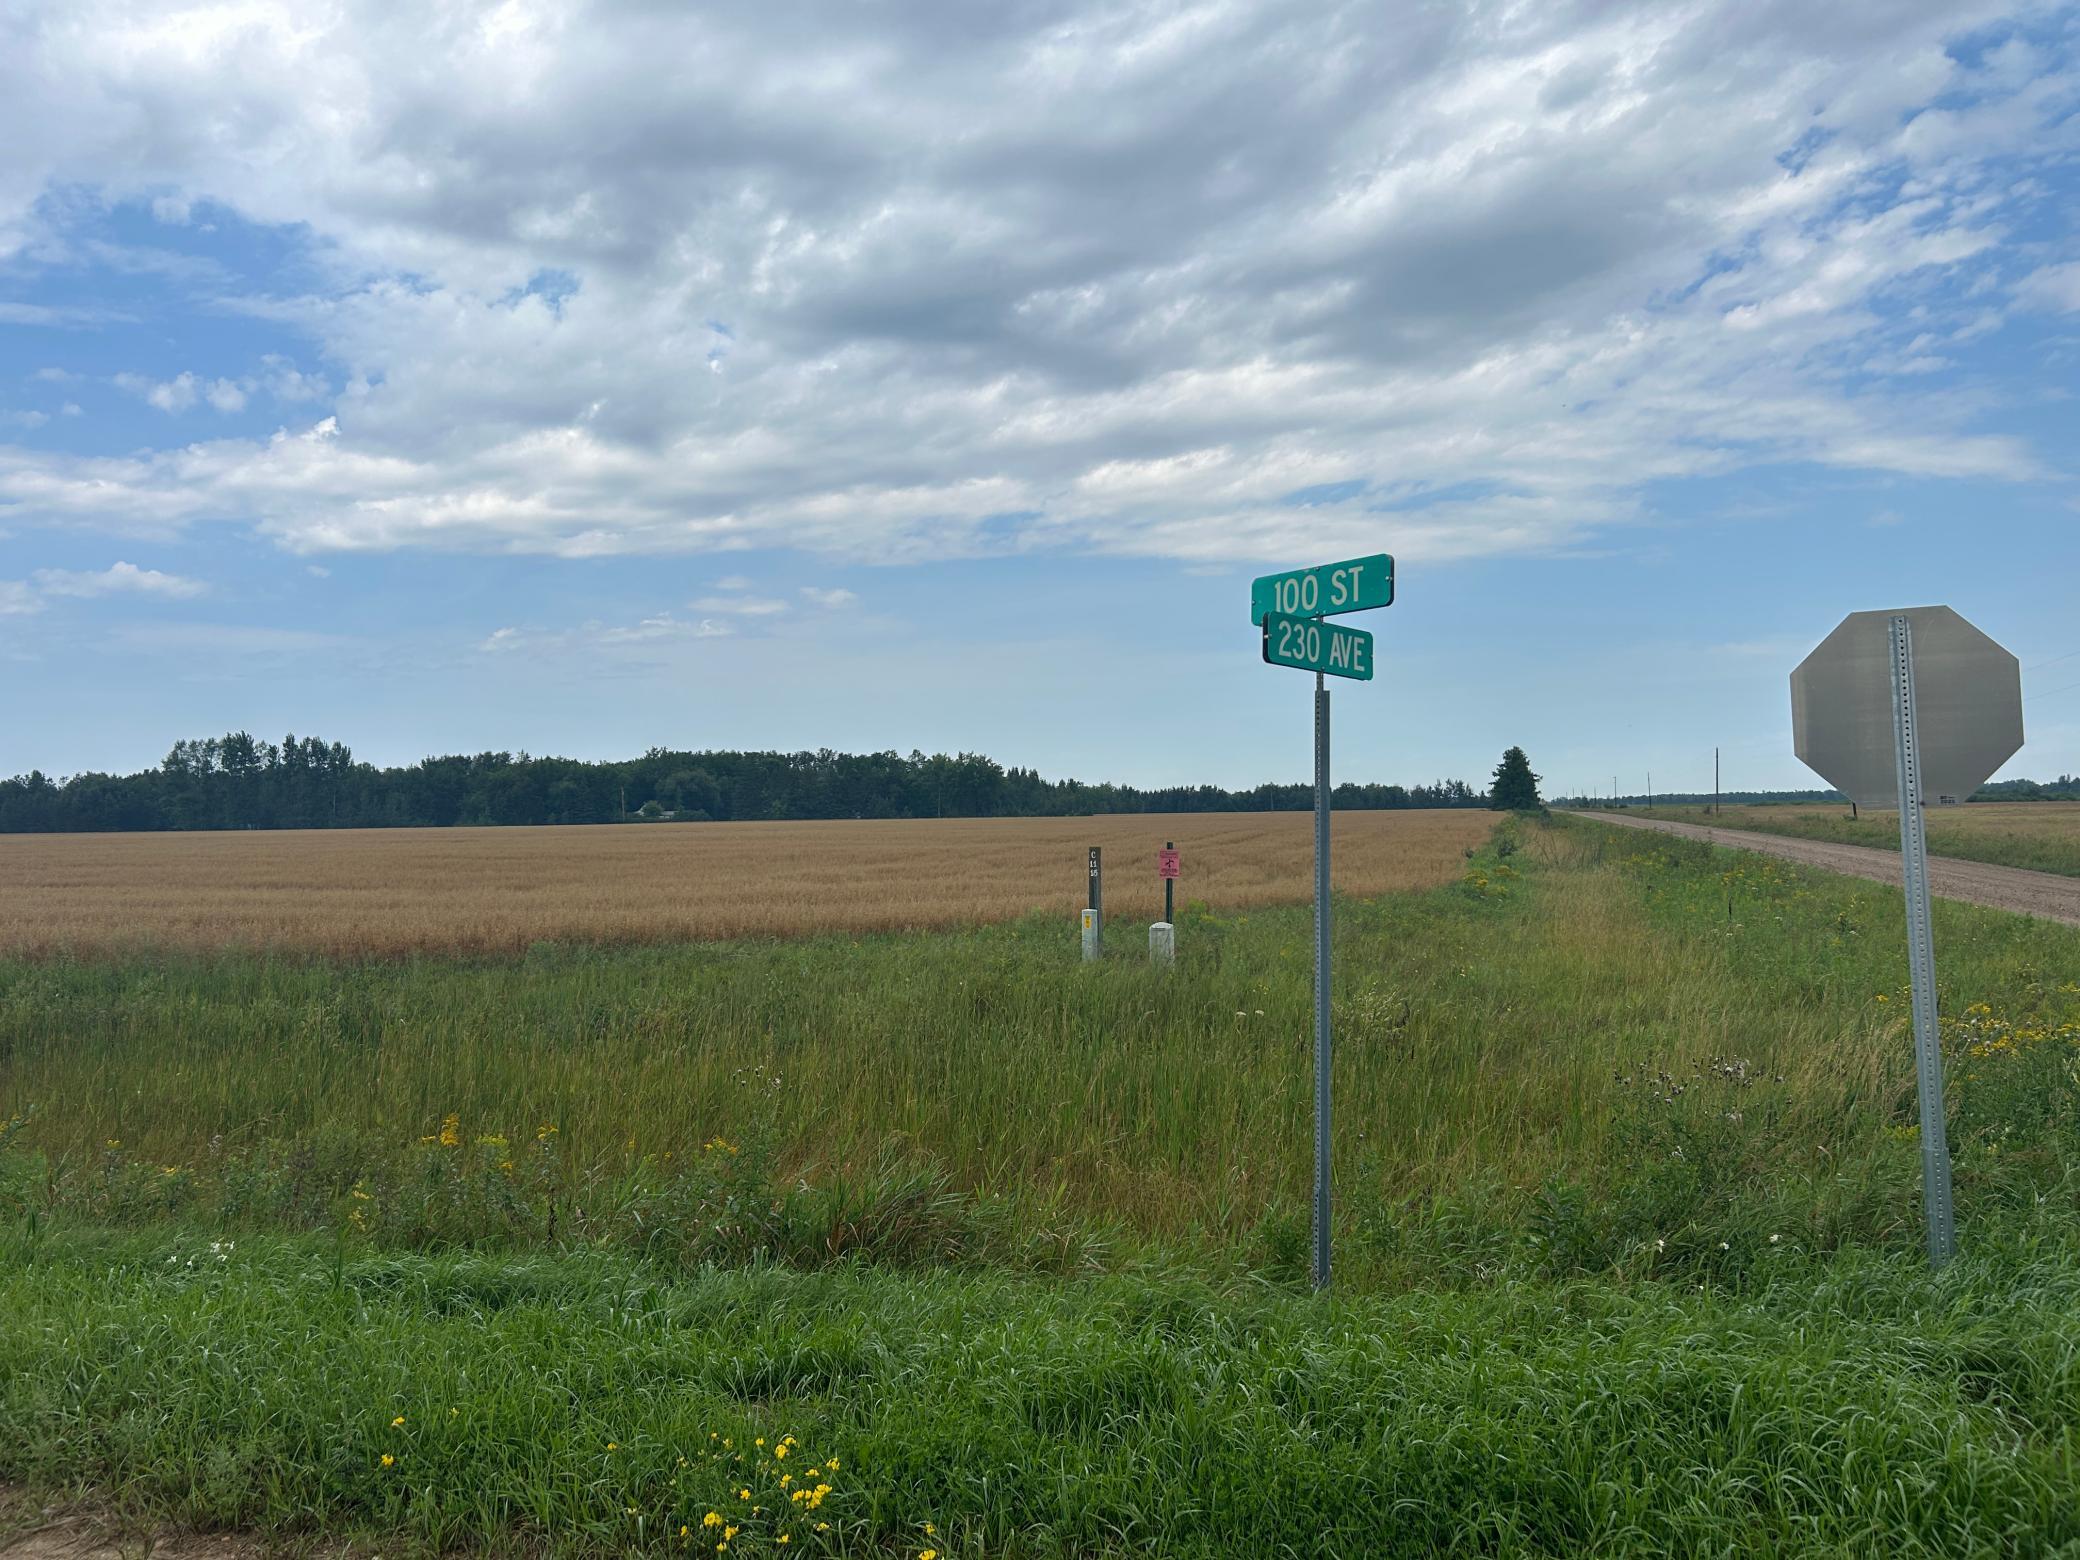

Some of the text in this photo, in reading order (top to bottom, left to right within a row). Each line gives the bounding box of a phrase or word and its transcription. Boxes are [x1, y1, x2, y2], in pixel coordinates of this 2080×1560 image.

[1275, 565, 1364, 614] 100 ST
[1278, 620, 1364, 672] 230 AVE
